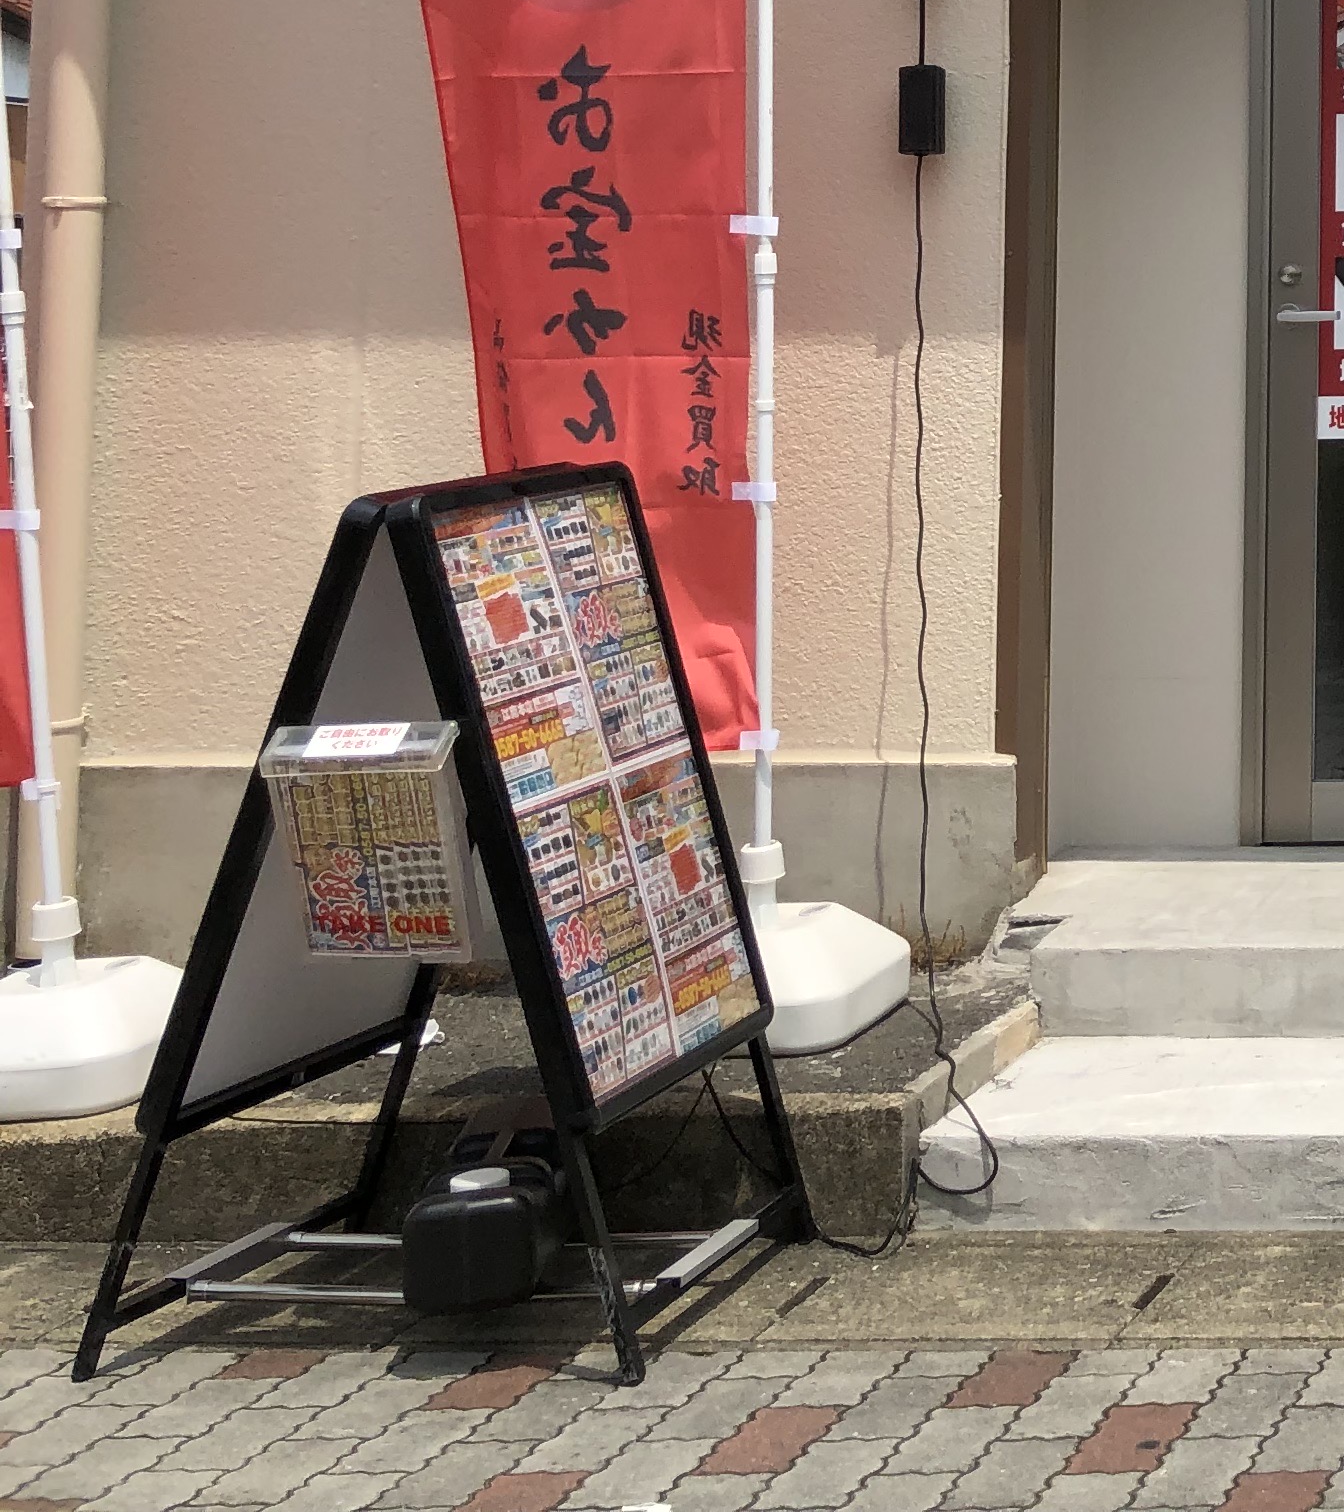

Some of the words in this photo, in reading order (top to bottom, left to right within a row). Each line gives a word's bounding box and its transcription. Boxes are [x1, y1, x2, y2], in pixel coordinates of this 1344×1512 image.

[332, 740, 378, 749] ください
[394, 915, 452, 935] ONE
